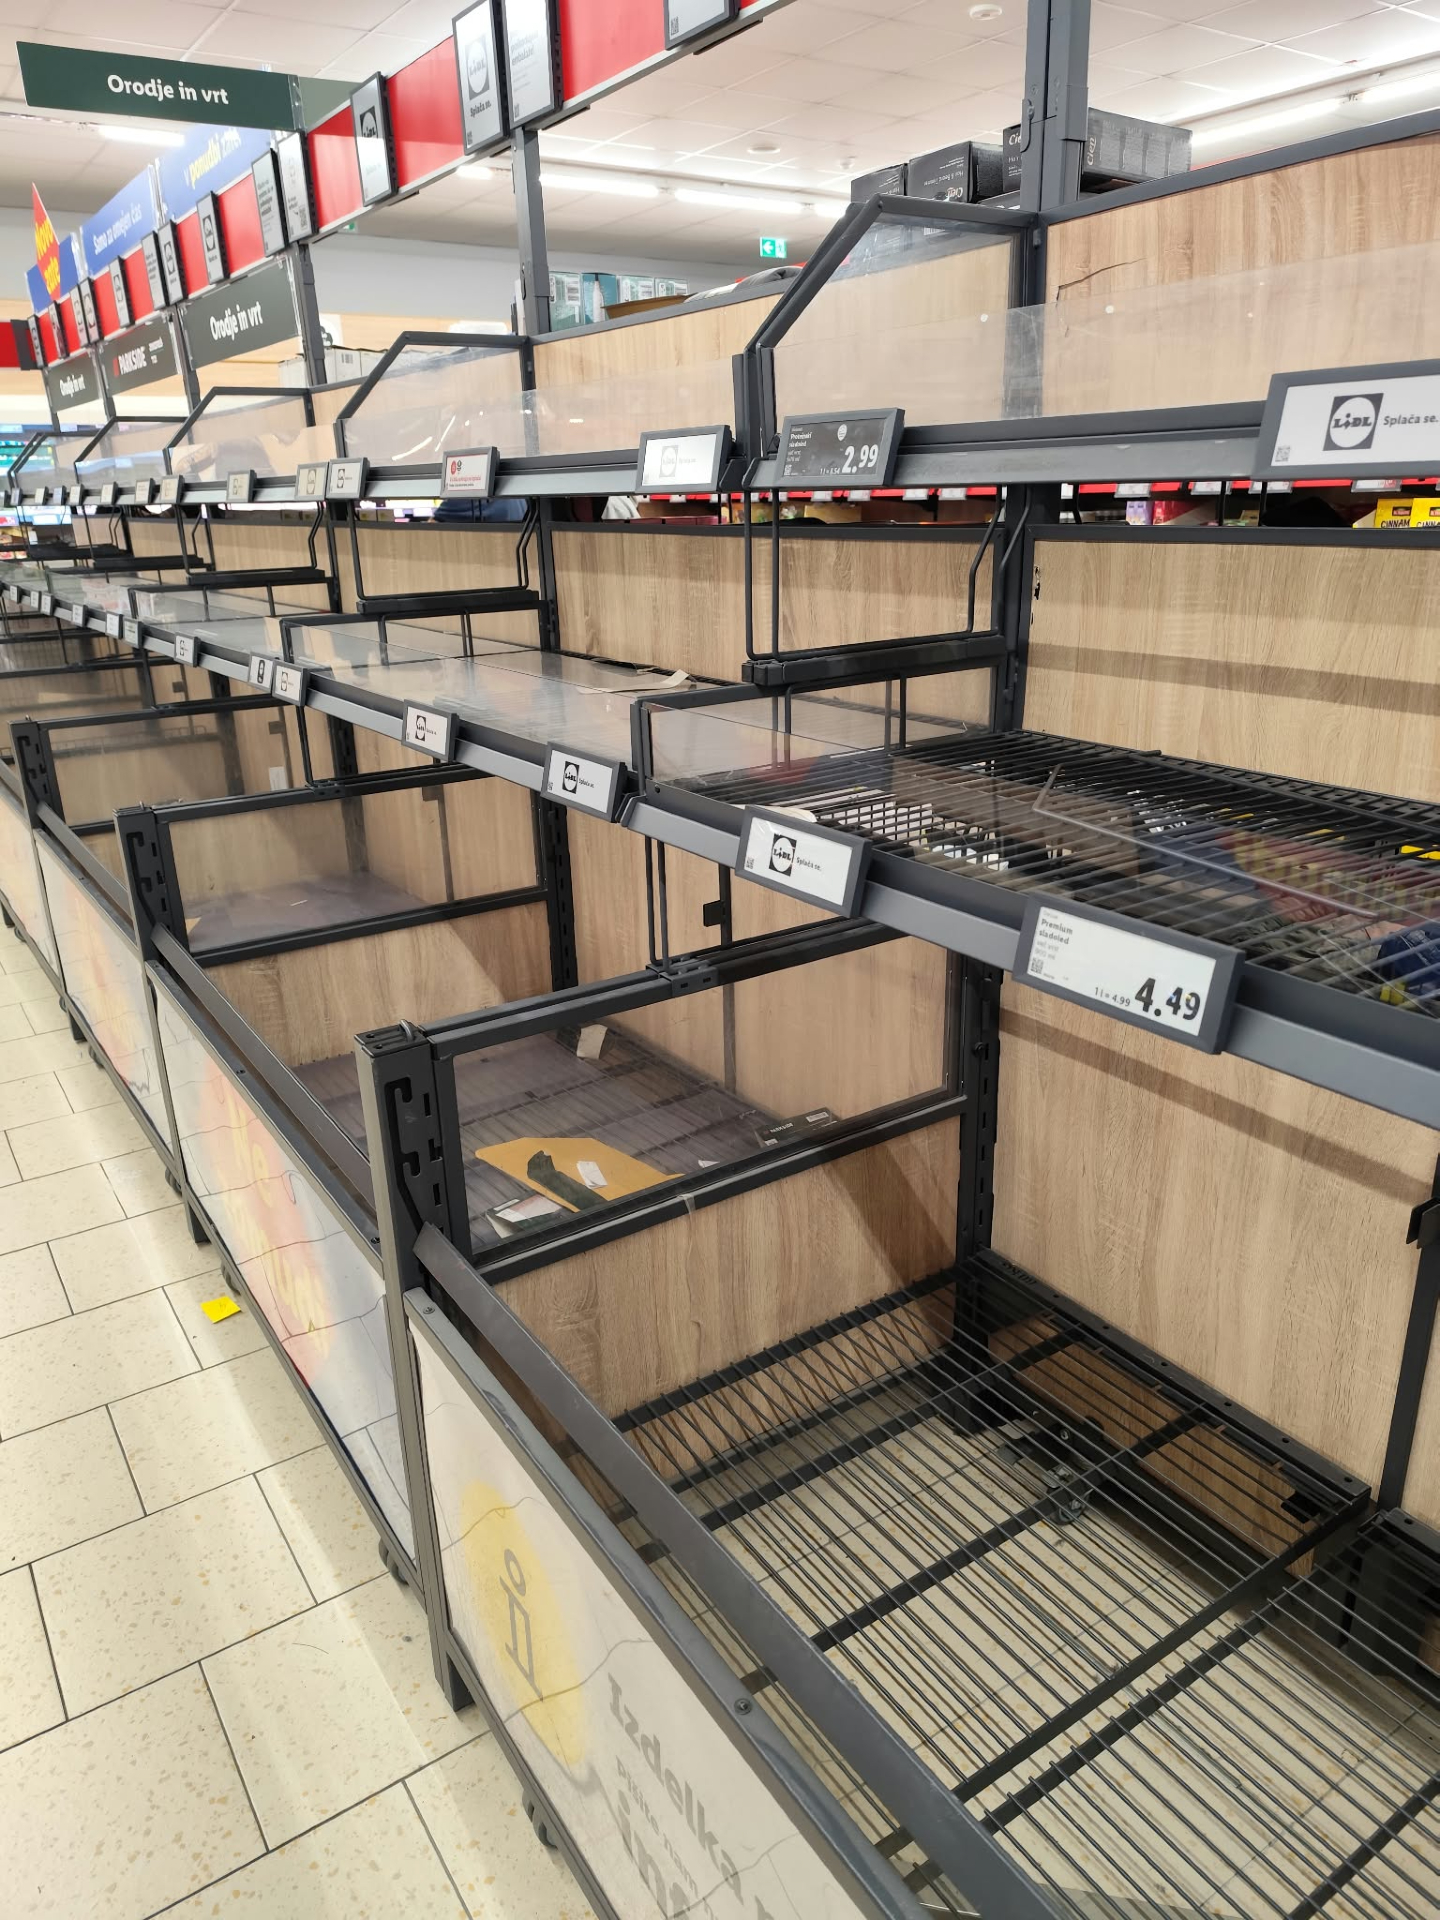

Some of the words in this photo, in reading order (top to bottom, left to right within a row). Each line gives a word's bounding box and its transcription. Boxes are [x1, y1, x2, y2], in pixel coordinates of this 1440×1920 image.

[107, 74, 174, 101] Orodje
[178, 80, 198, 101] in
[201, 88, 229, 104] vrt
[1009, 132, 1021, 145] Cie
[1086, 135, 1097, 166] Cien
[210, 307, 239, 341] Orodje
[236, 304, 249, 332] in
[248, 301, 264, 326] vrt
[118, 346, 147, 376] PARKSIDE
[1383, 413, 1421, 428] Splača
[1422, 413, 1439, 424] se.
[842, 444, 879, 474] 2.99
[1380, 518, 1411, 529] CINNAM
[1038, 929, 1071, 945] sladoled
[1040, 918, 1074, 936] Premium
[1111, 992, 1132, 1007] 4.99
[1134, 977, 1202, 1021] 4.49
[607, 1671, 745, 1907] Izdelka
